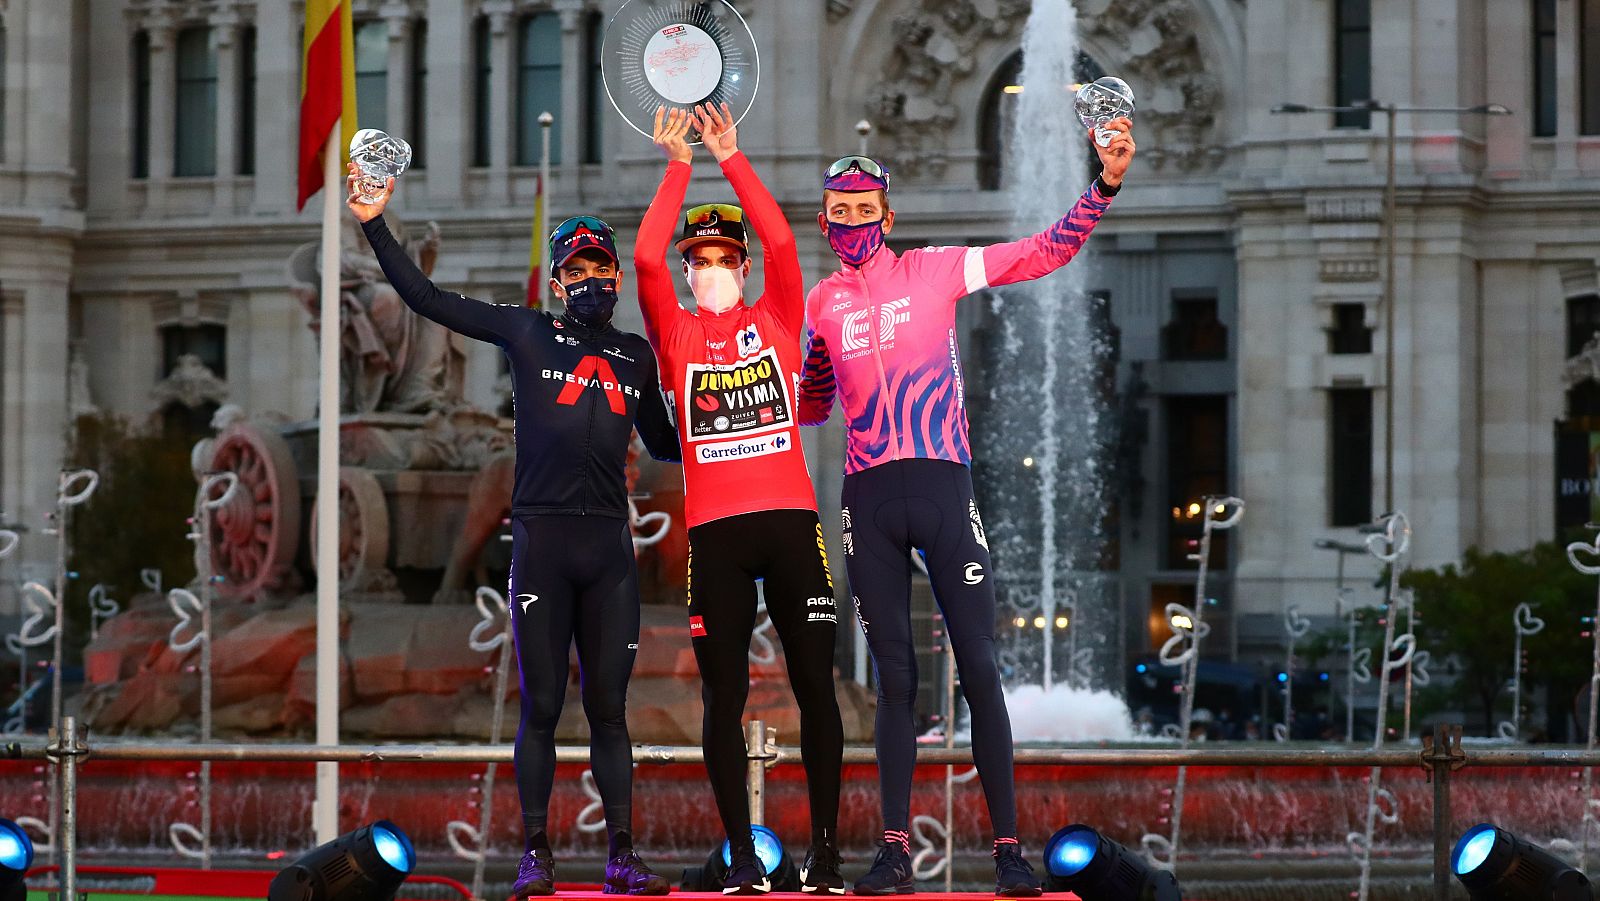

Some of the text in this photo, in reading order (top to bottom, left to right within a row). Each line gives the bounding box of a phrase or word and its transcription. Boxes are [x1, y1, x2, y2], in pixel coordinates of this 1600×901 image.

[832, 301, 852, 312] POC
[842, 342, 895, 361] Education First
[696, 359, 772, 391] JUMBO
[948, 328, 964, 409] cannondale
[723, 380, 779, 410] VISMA
[731, 410, 756, 420] ZUIVER
[694, 425, 712, 434] Better
[701, 442, 767, 459] Carrefour
